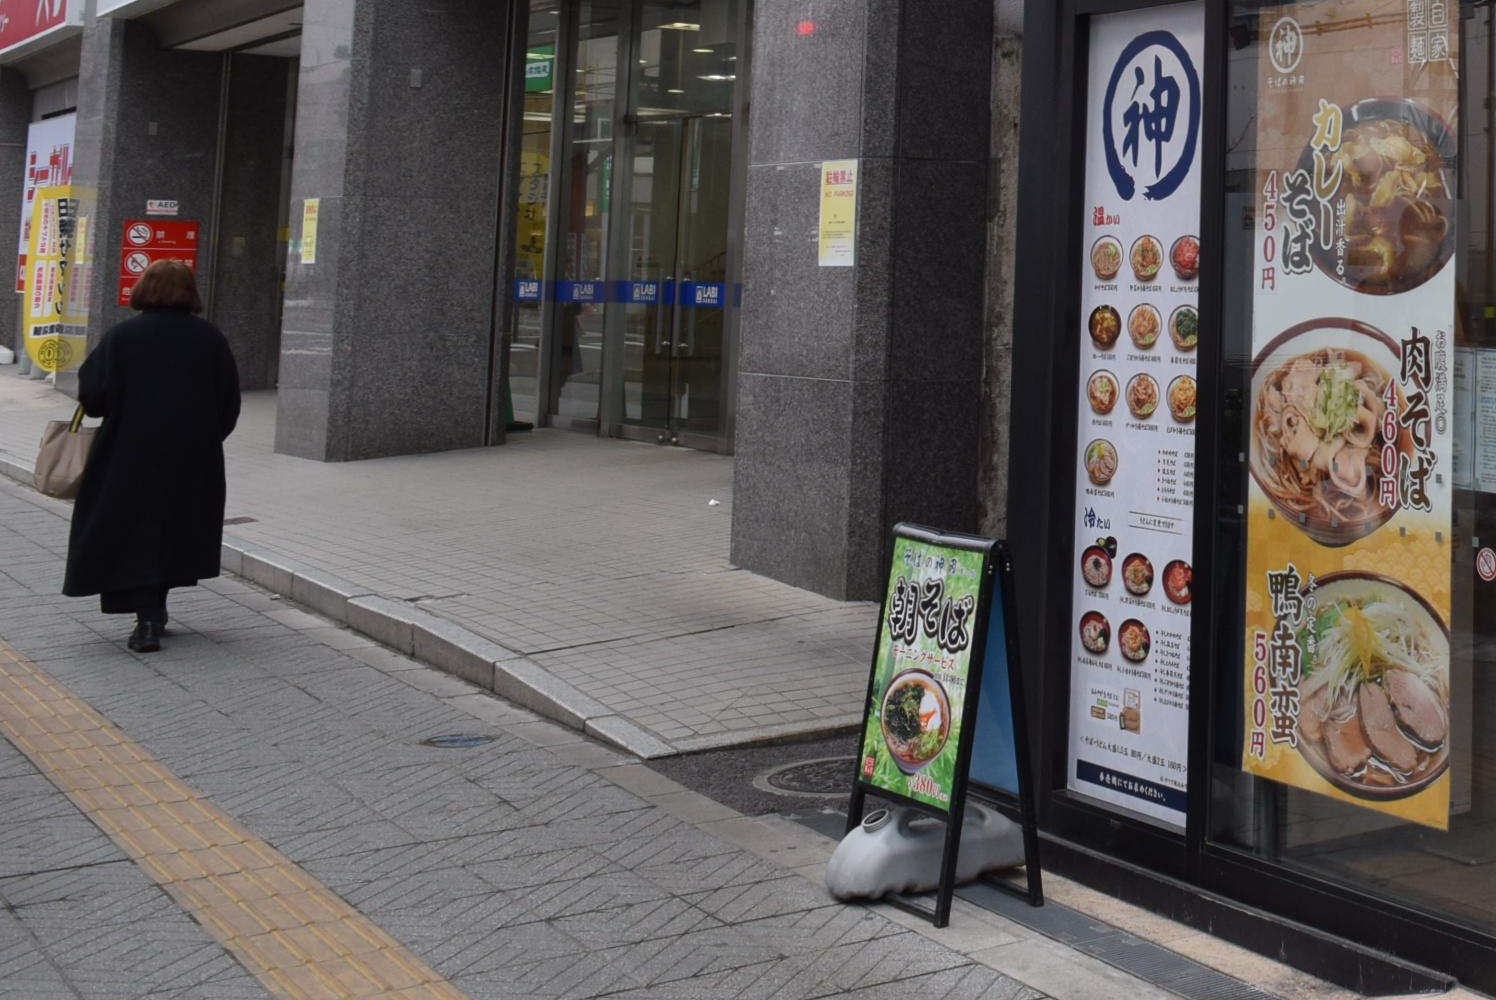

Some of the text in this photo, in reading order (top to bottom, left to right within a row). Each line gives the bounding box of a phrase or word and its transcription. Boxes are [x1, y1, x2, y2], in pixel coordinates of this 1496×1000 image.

[1122, 53, 1182, 180] 神
[1311, 98, 1345, 250] カレー
[1262, 170, 1278, 291] 450円
[1280, 169, 1314, 274] そば
[703, 286, 718, 297] LABI
[1379, 378, 1398, 509] 460円
[1400, 327, 1436, 512] 肉そば
[1082, 506, 1111, 532] 冷たい
[889, 576, 974, 653] 朝そば
[892, 645, 955, 671] モーニングサービス
[1267, 564, 1302, 748] 鴨南蛮
[1250, 632, 1267, 760] 560円
